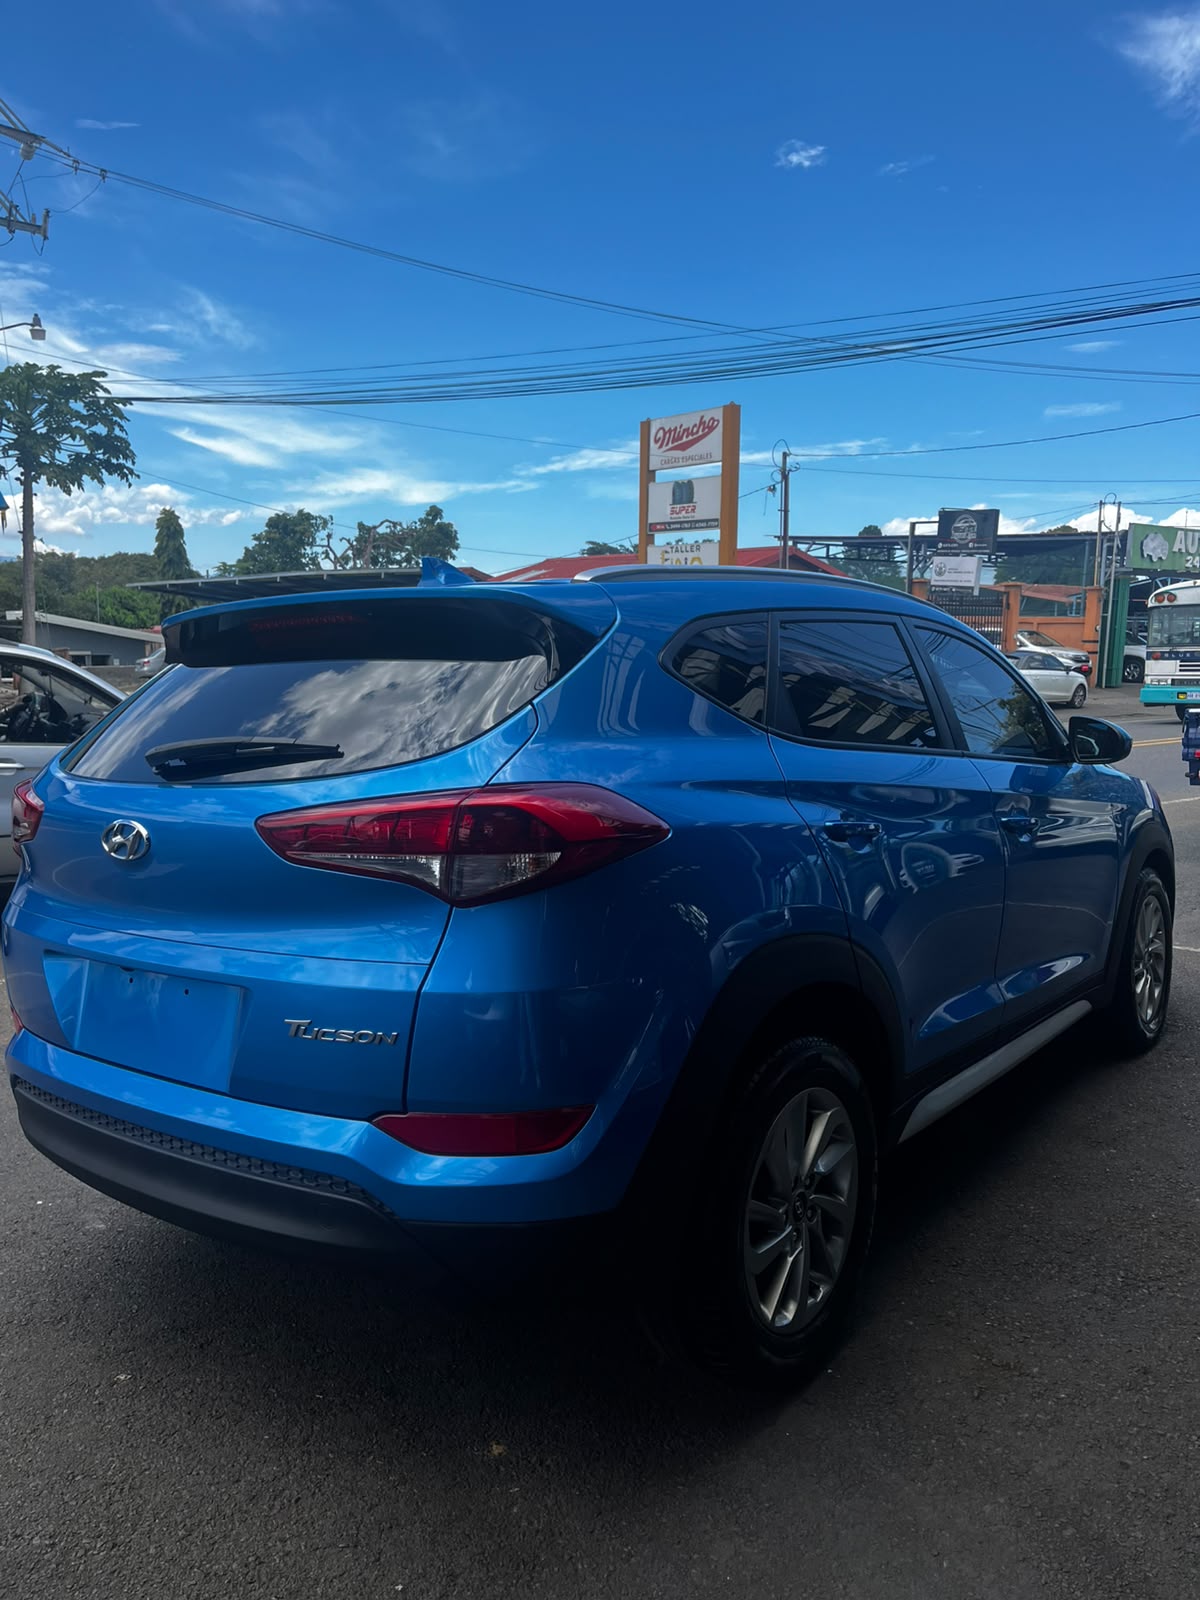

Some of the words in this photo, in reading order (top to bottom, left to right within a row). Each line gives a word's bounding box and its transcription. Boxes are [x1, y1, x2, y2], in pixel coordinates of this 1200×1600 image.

[661, 456, 680, 466] CARGAS
[681, 452, 713, 464] ESPECIALES
[669, 504, 697, 516] SUPER
[669, 544, 702, 554] TALLER
[284, 1018, 398, 1045] TUCSON
